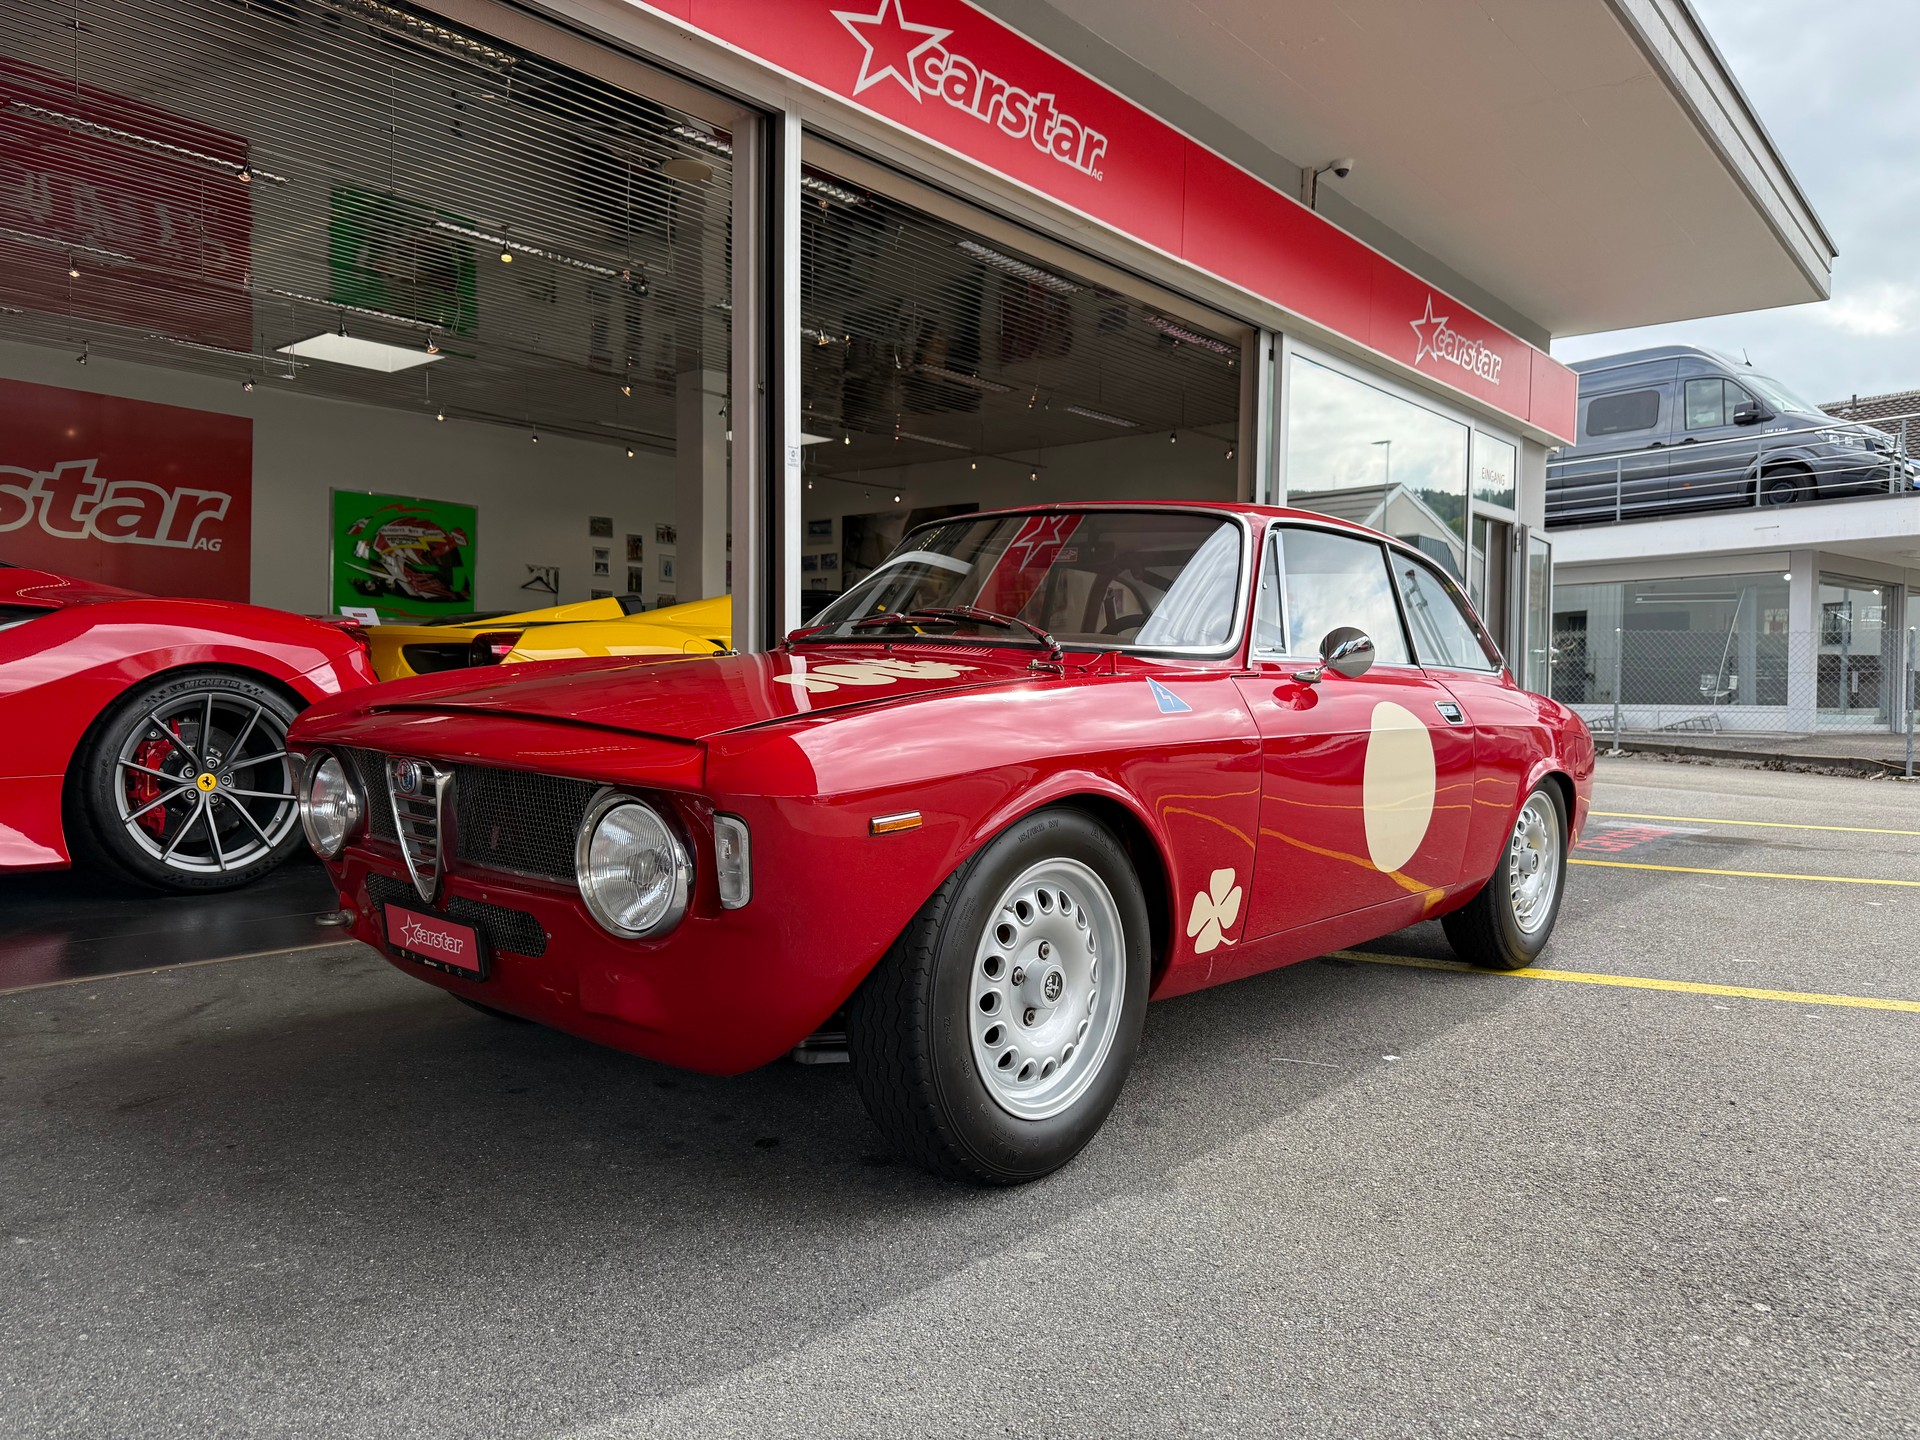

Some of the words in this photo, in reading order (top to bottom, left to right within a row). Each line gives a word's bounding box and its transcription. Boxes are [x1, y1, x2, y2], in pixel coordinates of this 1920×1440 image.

[910, 43, 1108, 175] carstar
[1090, 168, 1103, 181] AG
[1433, 326, 1502, 382] carstar
[1481, 467, 1505, 486] EINGANG
[194, 537, 222, 551] AG
[184, 679, 240, 689] MICHELIN
[414, 927, 463, 954] carstar
